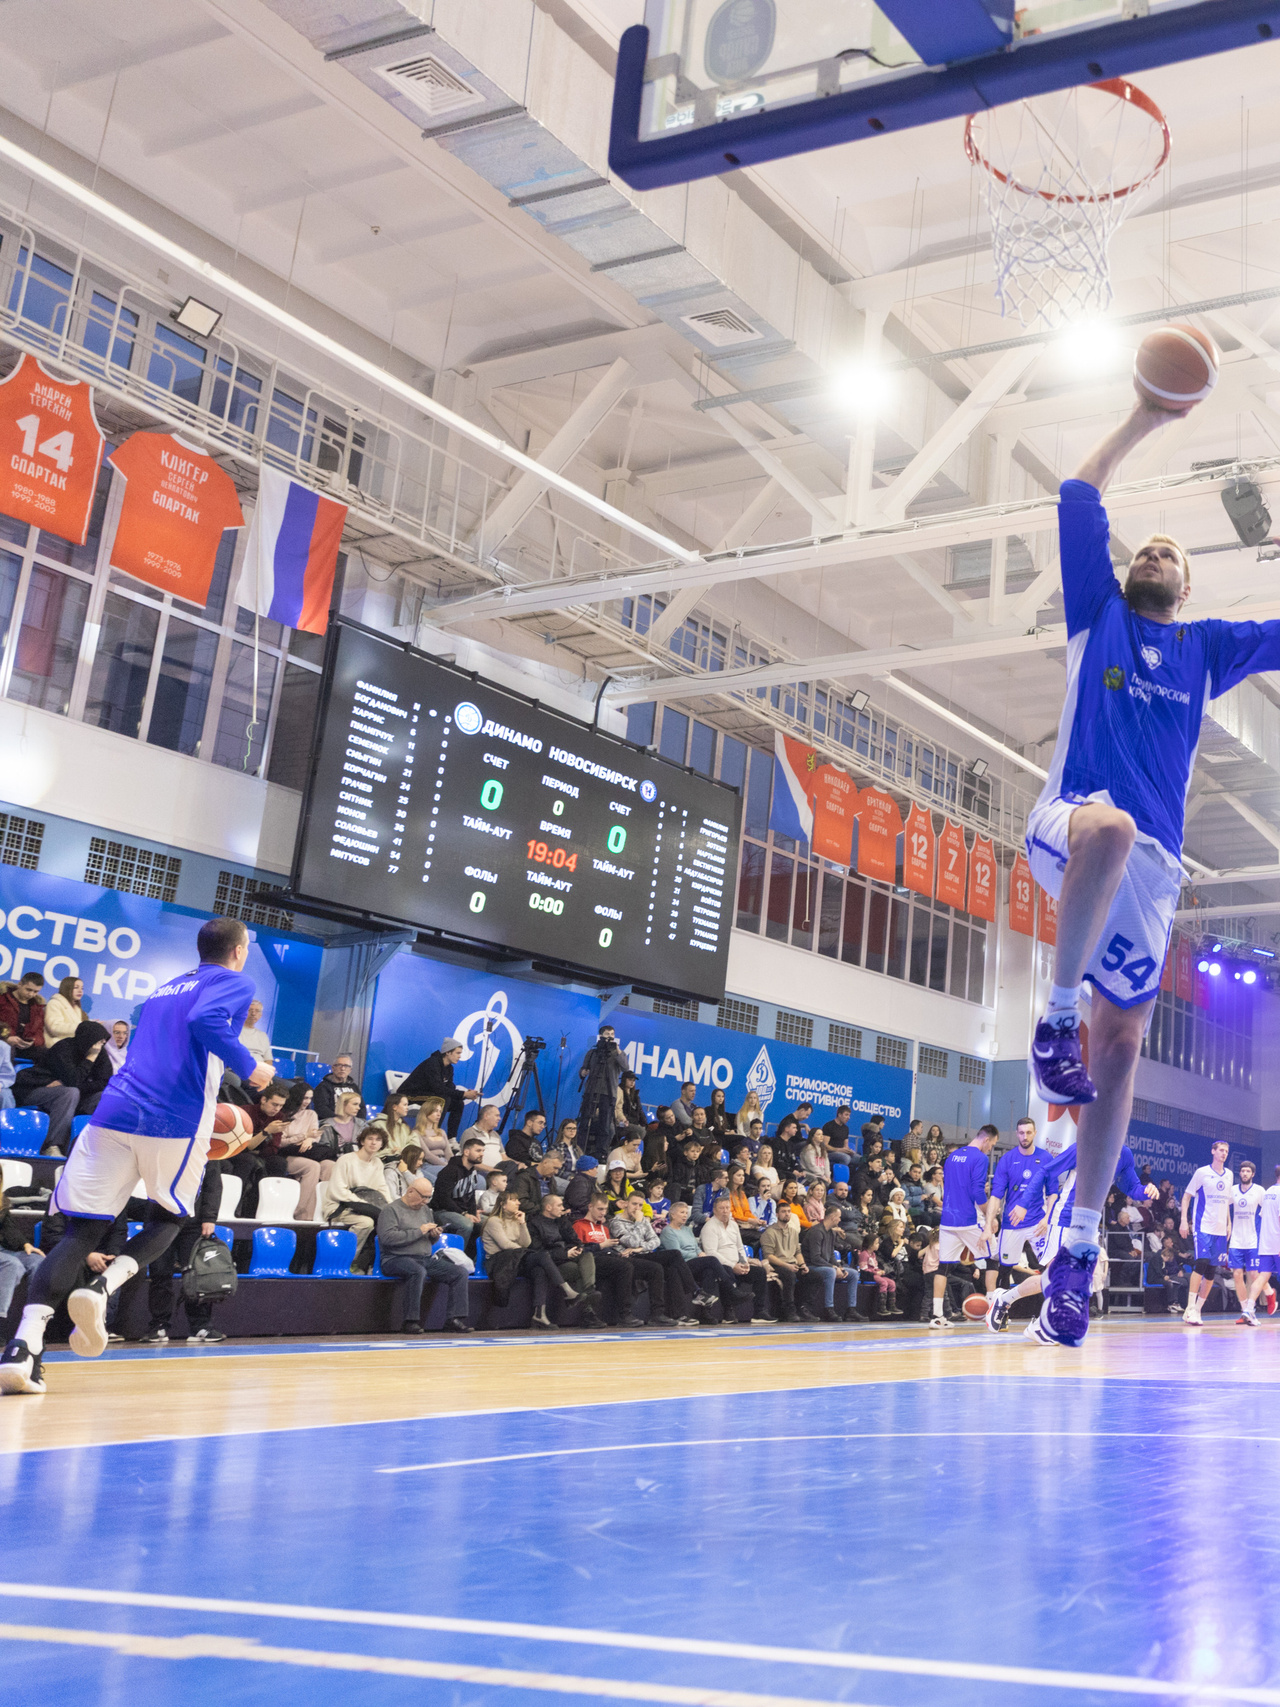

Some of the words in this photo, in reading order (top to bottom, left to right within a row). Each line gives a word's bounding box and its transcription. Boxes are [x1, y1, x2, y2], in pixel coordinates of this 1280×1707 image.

[29, 392, 73, 422] ТЕРЕХИН
[35, 382, 72, 408] АНДРЕЙ
[16, 414, 74, 473] 14
[10, 454, 68, 490] СПАРТАК
[160, 450, 209, 485] КЛИГЕР
[168, 472, 195, 491] СЕРГЕЙ
[11, 491, 56, 515] 1999-2002
[14, 483, 56, 506] 1980-1988
[152, 490, 200, 524] СПАРТАК
[143, 557, 182, 579] 1999-2009
[147, 551, 182, 572] 1973-1976
[357, 681, 398, 702] ФАМИЛИЯ
[1128, 685, 1152, 706] КРАЙ
[1131, 672, 1190, 706] ПРИМОРСКИЙ
[352, 706, 385, 724] ХАРРИС
[354, 692, 408, 718] БОГДАНОВИЧ
[350, 720, 395, 742] ПИЛИПЧУК
[408, 742, 415, 750] 11
[482, 720, 543, 753] ДИНАМО
[348, 734, 389, 754] СЕМЕНЮК
[406, 755, 414, 764] 15
[483, 753, 510, 770] СЧЕТ
[346, 748, 382, 767] СМЫГИН
[402, 768, 412, 777] 21
[548, 746, 639, 792] НОВОСИБИРСК
[343, 762, 387, 783] КОРЧАГИН
[400, 782, 410, 791] 24
[542, 775, 579, 798] ПЕРИОД
[341, 776, 372, 792] ГРАЧЕВ
[398, 796, 408, 804] 25
[480, 780, 503, 810] 0
[339, 791, 373, 808] СИТНИК
[396, 809, 407, 818] 30
[553, 800, 564, 816] 0
[609, 802, 632, 816] СЧЕТ
[337, 805, 366, 819] ИОНОВ
[394, 823, 404, 832] 36
[463, 815, 513, 840] ТАЙМ-АУТ
[540, 820, 572, 839] ВРЕМЯ
[335, 820, 378, 838] СОЛОВЬЕВ
[393, 838, 402, 846] 41
[608, 826, 626, 853] 0
[332, 834, 379, 854] ФЕДЮШИН
[390, 851, 400, 860] 54
[527, 840, 578, 872] 19:04
[911, 832, 928, 860] 12
[330, 848, 370, 866] МИТУСОВ
[388, 865, 399, 873] 77
[593, 859, 635, 880] ТАЙМ-АУТ
[948, 848, 958, 871] 7
[464, 866, 498, 883] ФОЛЫ
[527, 870, 572, 892] ТАЙМ-АУТ
[975, 862, 990, 887] 12
[470, 892, 486, 912] 0
[529, 893, 564, 915] 0:00
[1016, 880, 1030, 903] 13
[594, 905, 622, 920] ФОЛЫ
[0, 904, 141, 960] СТВО
[599, 928, 612, 948] 0
[1101, 932, 1158, 992] 54
[92, 963, 157, 1001] КР
[597, 1035, 734, 1090] ИНАМО
[786, 1074, 853, 1098] ПРИМОРСКОЕ
[785, 1087, 851, 1108] СПОРТИВНОЕ
[852, 1099, 902, 1118] ОБЩЕСТВО
[1125, 1134, 1185, 1158] АВИТЕЛЬСТВО
[1134, 1154, 1176, 1173] ОРСКОГО
[1250, 1258, 1260, 1267] 15
